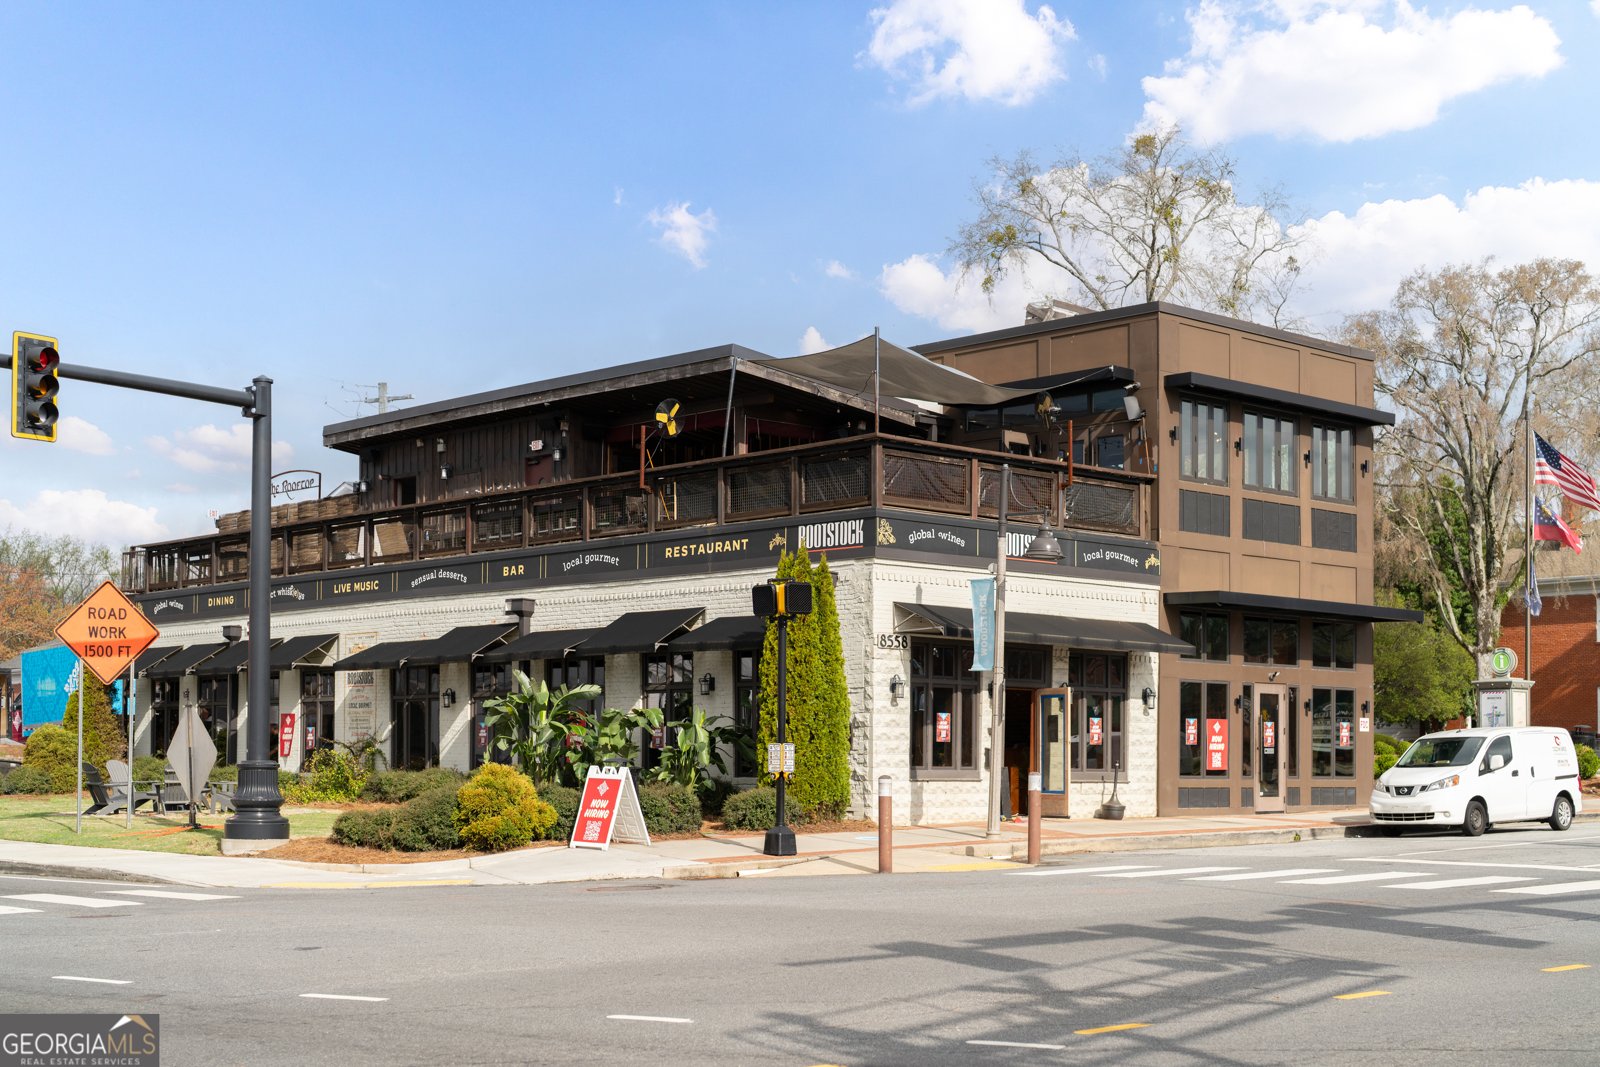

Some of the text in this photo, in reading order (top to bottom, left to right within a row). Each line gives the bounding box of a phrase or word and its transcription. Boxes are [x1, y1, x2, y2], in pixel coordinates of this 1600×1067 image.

[798, 519, 864, 549] ROOTSTOCK
[908, 528, 966, 548] global wines
[665, 538, 749, 559] RESTAURANT
[562, 554, 620, 572] local gourmet
[1083, 549, 1139, 568] local gourmet
[502, 565, 525, 577] BAR
[410, 569, 468, 588] sensual desserts
[333, 580, 379, 594] LIVE MUSIC
[208, 595, 235, 607] DINING
[88, 607, 127, 620] ROAD
[88, 627, 127, 639] WORK
[880, 634, 908, 649] 8558
[84, 645, 132, 658] 1500 FT
[590, 799, 609, 808] NOW
[583, 809, 610, 819] HIRING
